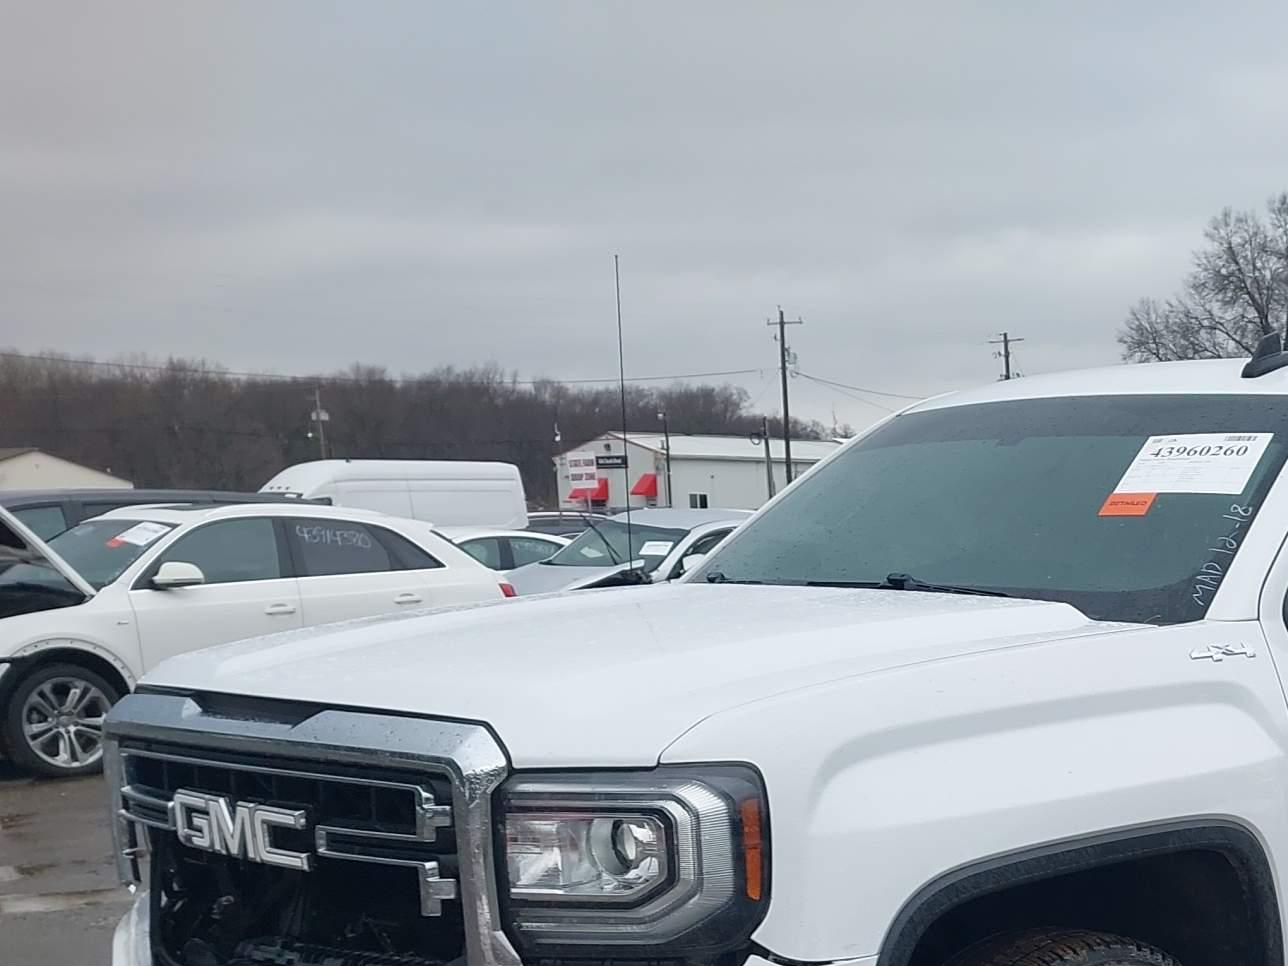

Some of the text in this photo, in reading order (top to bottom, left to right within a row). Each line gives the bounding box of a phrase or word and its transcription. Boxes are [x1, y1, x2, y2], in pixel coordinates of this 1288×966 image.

[1150, 445, 1249, 458] 43960260
[1192, 562, 1223, 606] MAD
[173, 788, 312, 872] GMC
